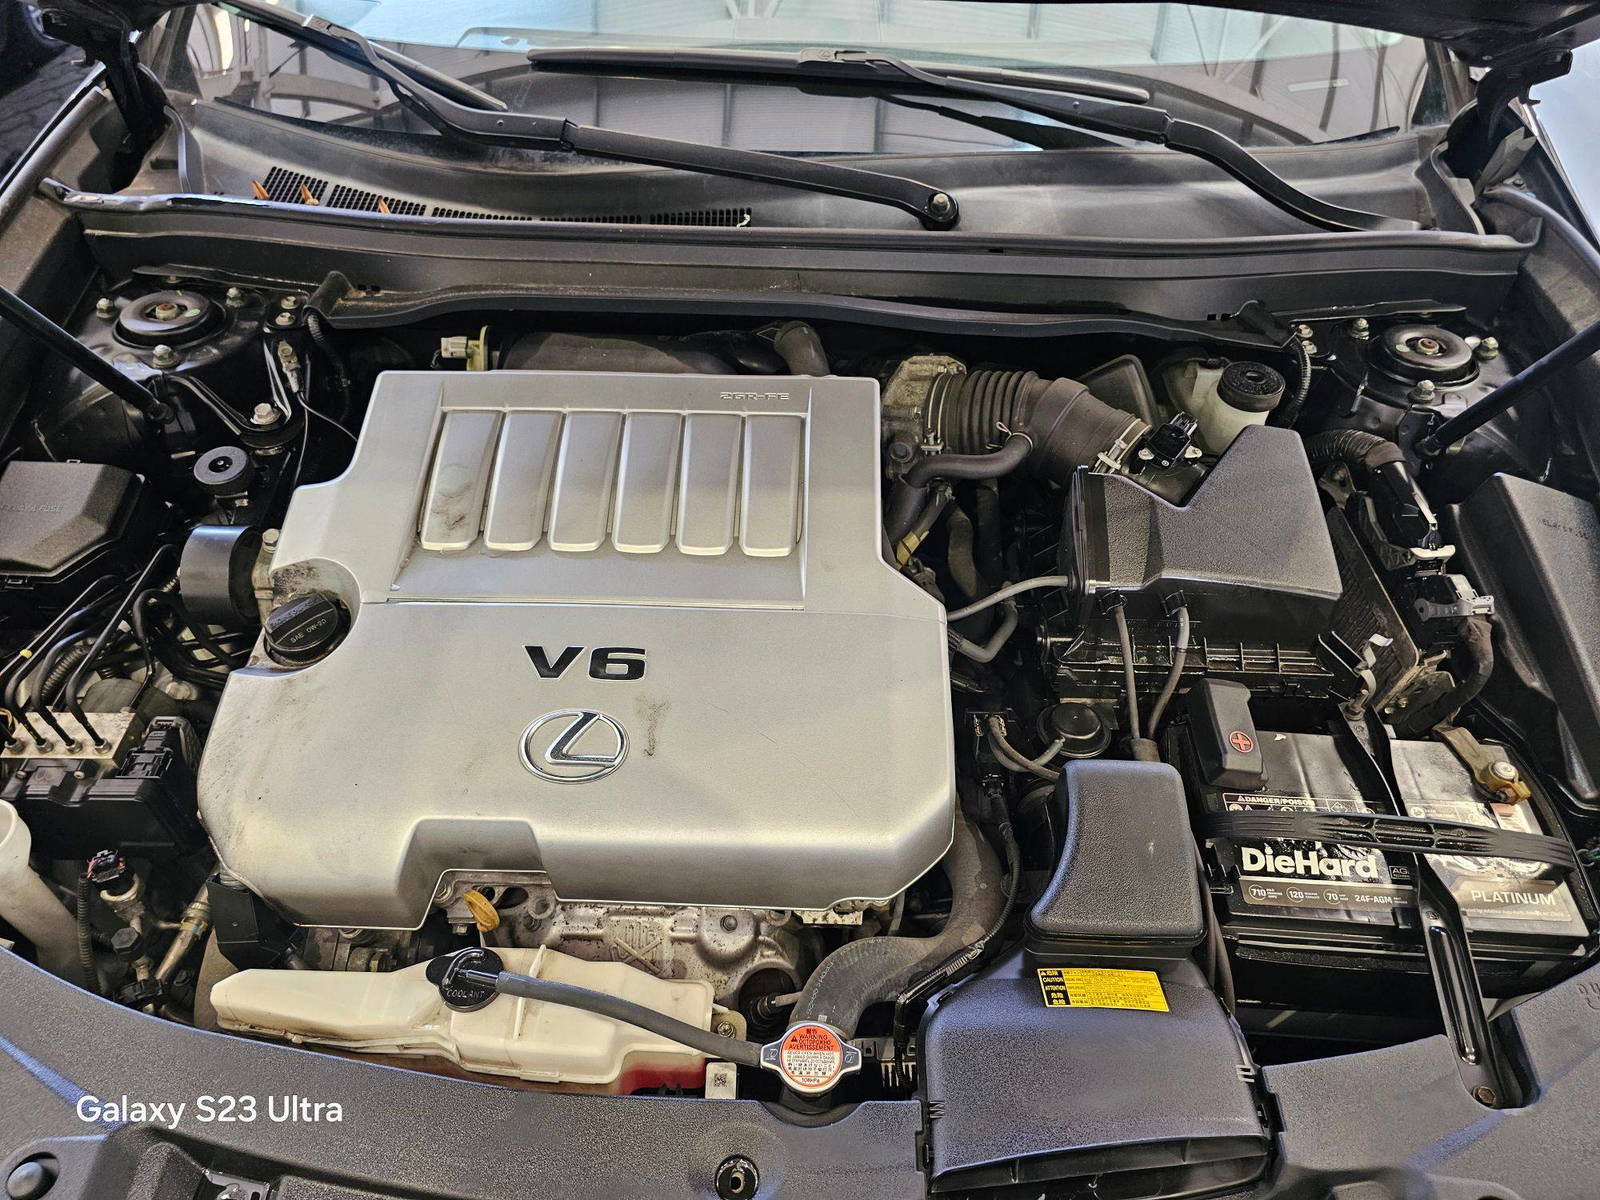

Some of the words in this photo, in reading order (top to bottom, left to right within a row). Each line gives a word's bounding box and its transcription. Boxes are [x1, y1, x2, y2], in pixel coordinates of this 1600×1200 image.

[523, 646, 646, 681] V6
[1241, 846, 1379, 879] DieHard
[1251, 888, 1267, 897] 710
[1289, 890, 1304, 899] 120
[1326, 892, 1338, 901] 70
[1354, 894, 1393, 904] 24F-AGM
[1471, 890, 1556, 906] PLATINUM
[446, 989, 485, 999] COOLANT
